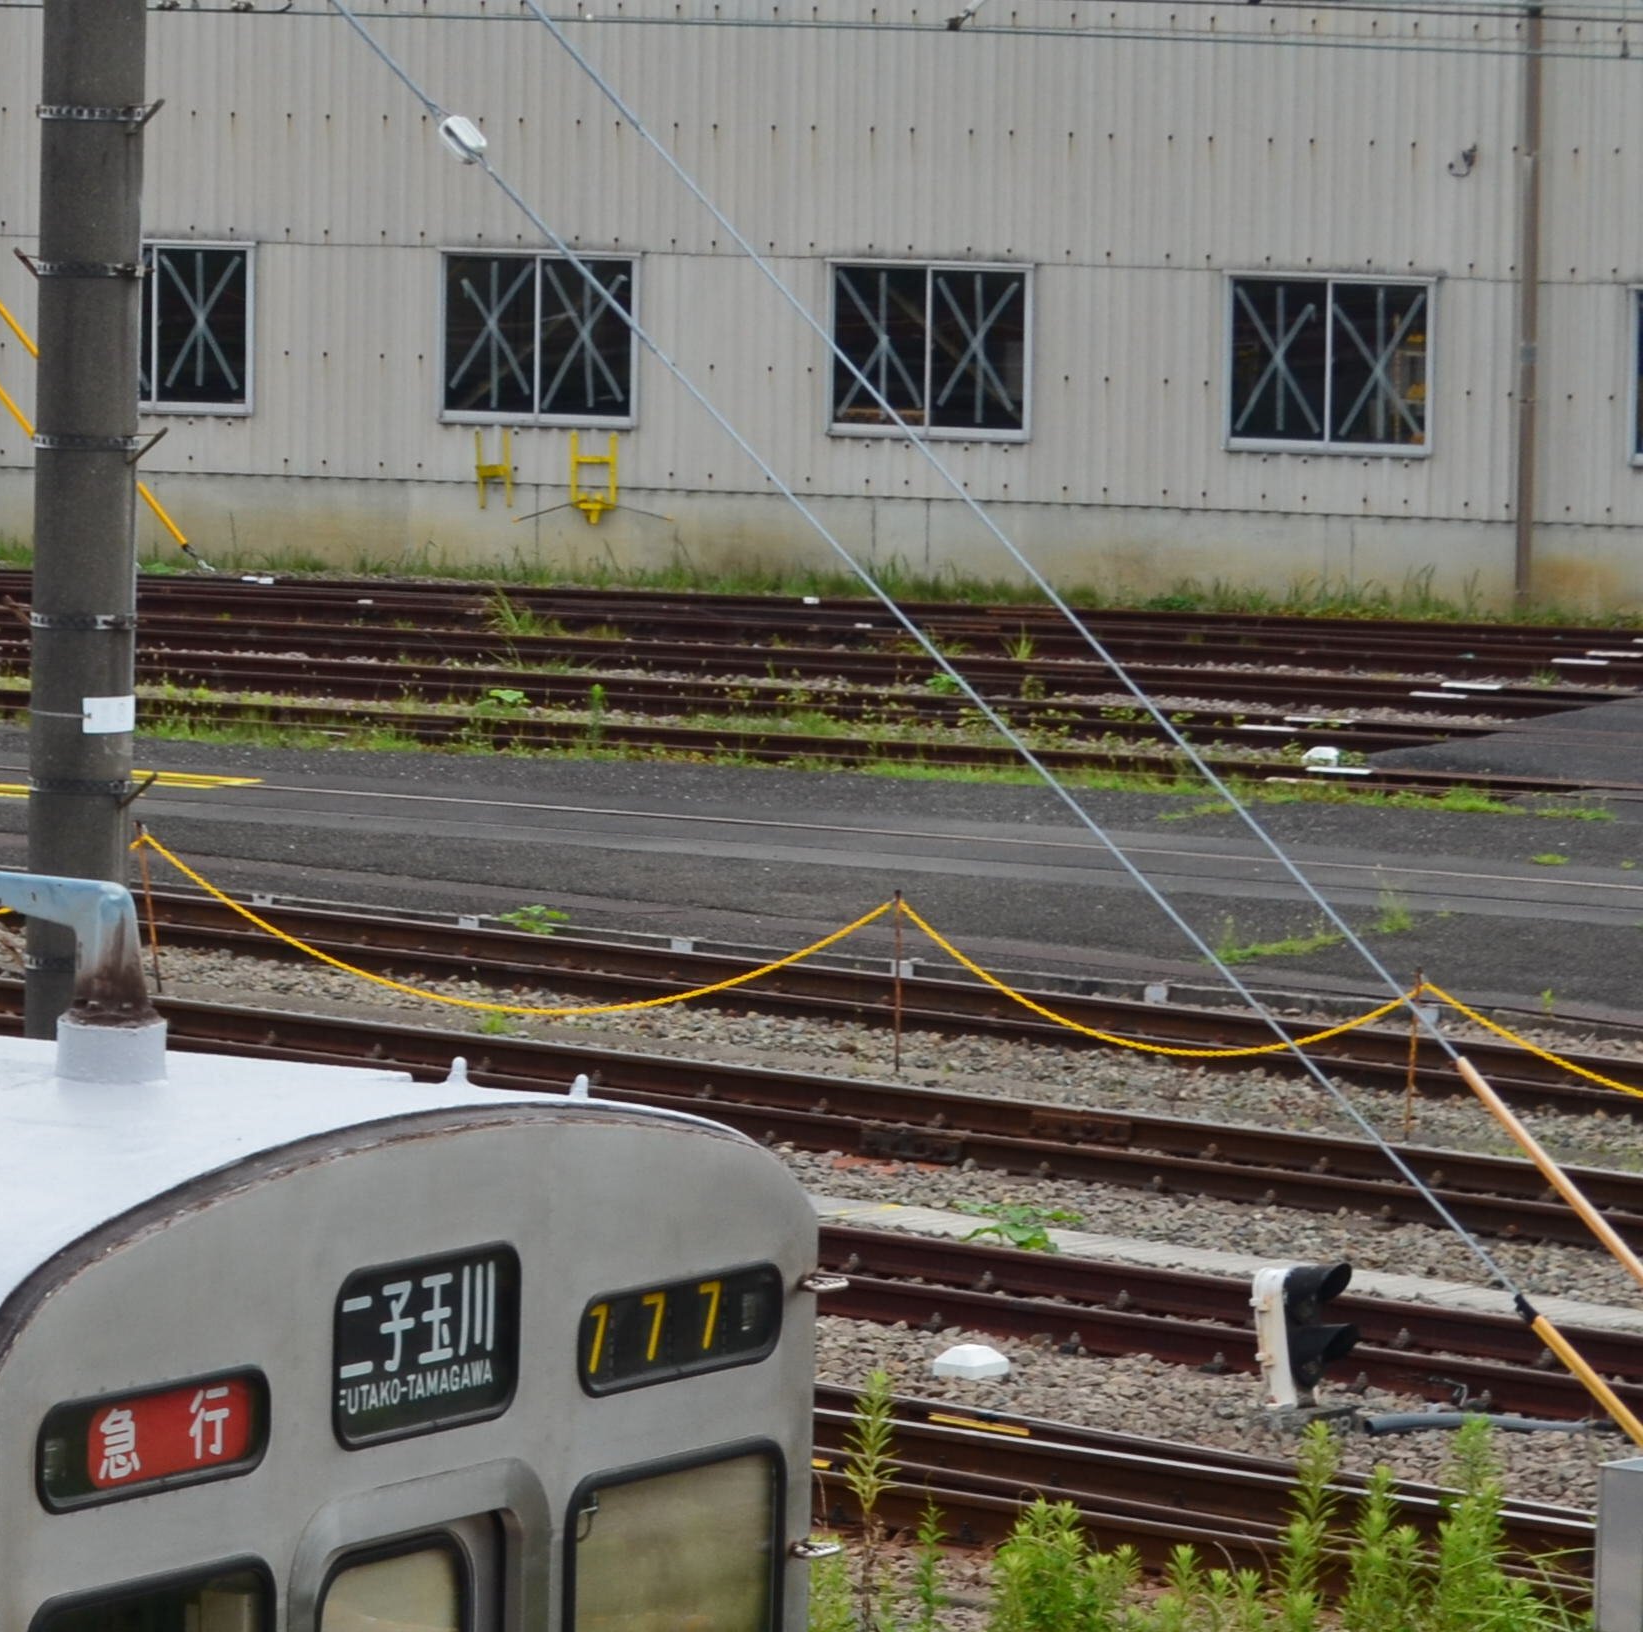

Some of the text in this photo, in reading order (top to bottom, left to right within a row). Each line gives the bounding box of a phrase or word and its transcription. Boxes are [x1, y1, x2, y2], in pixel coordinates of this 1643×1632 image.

[339, 1261, 496, 1373] 二子玉川
[98, 1386, 230, 1480] 急行
